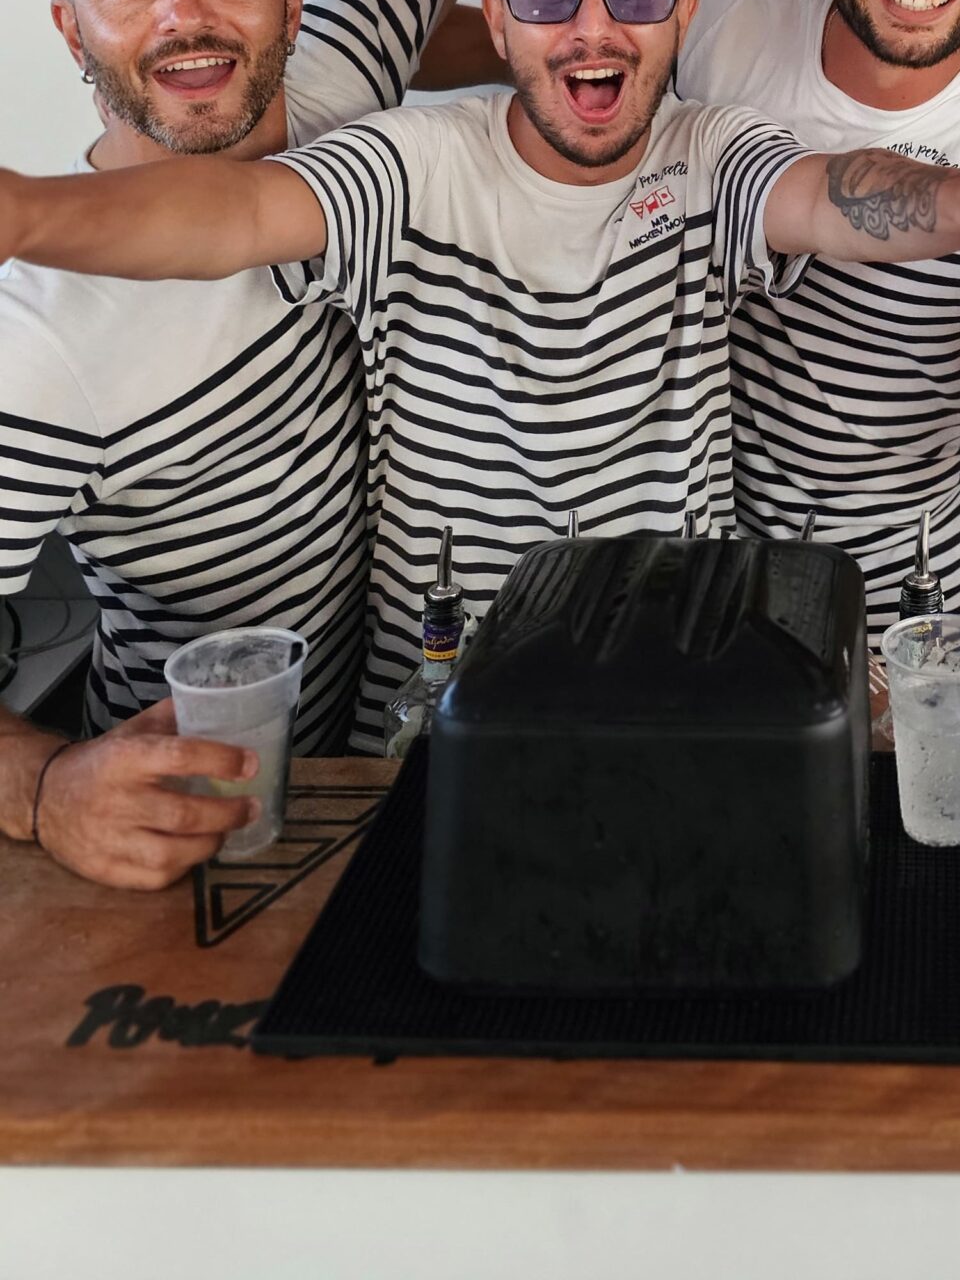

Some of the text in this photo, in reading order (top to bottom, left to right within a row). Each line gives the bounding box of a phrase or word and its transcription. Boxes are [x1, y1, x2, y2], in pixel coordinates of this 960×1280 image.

[638, 172, 660, 189] per
[650, 213, 670, 228] M/B
[628, 228, 664, 250] MICKEY
